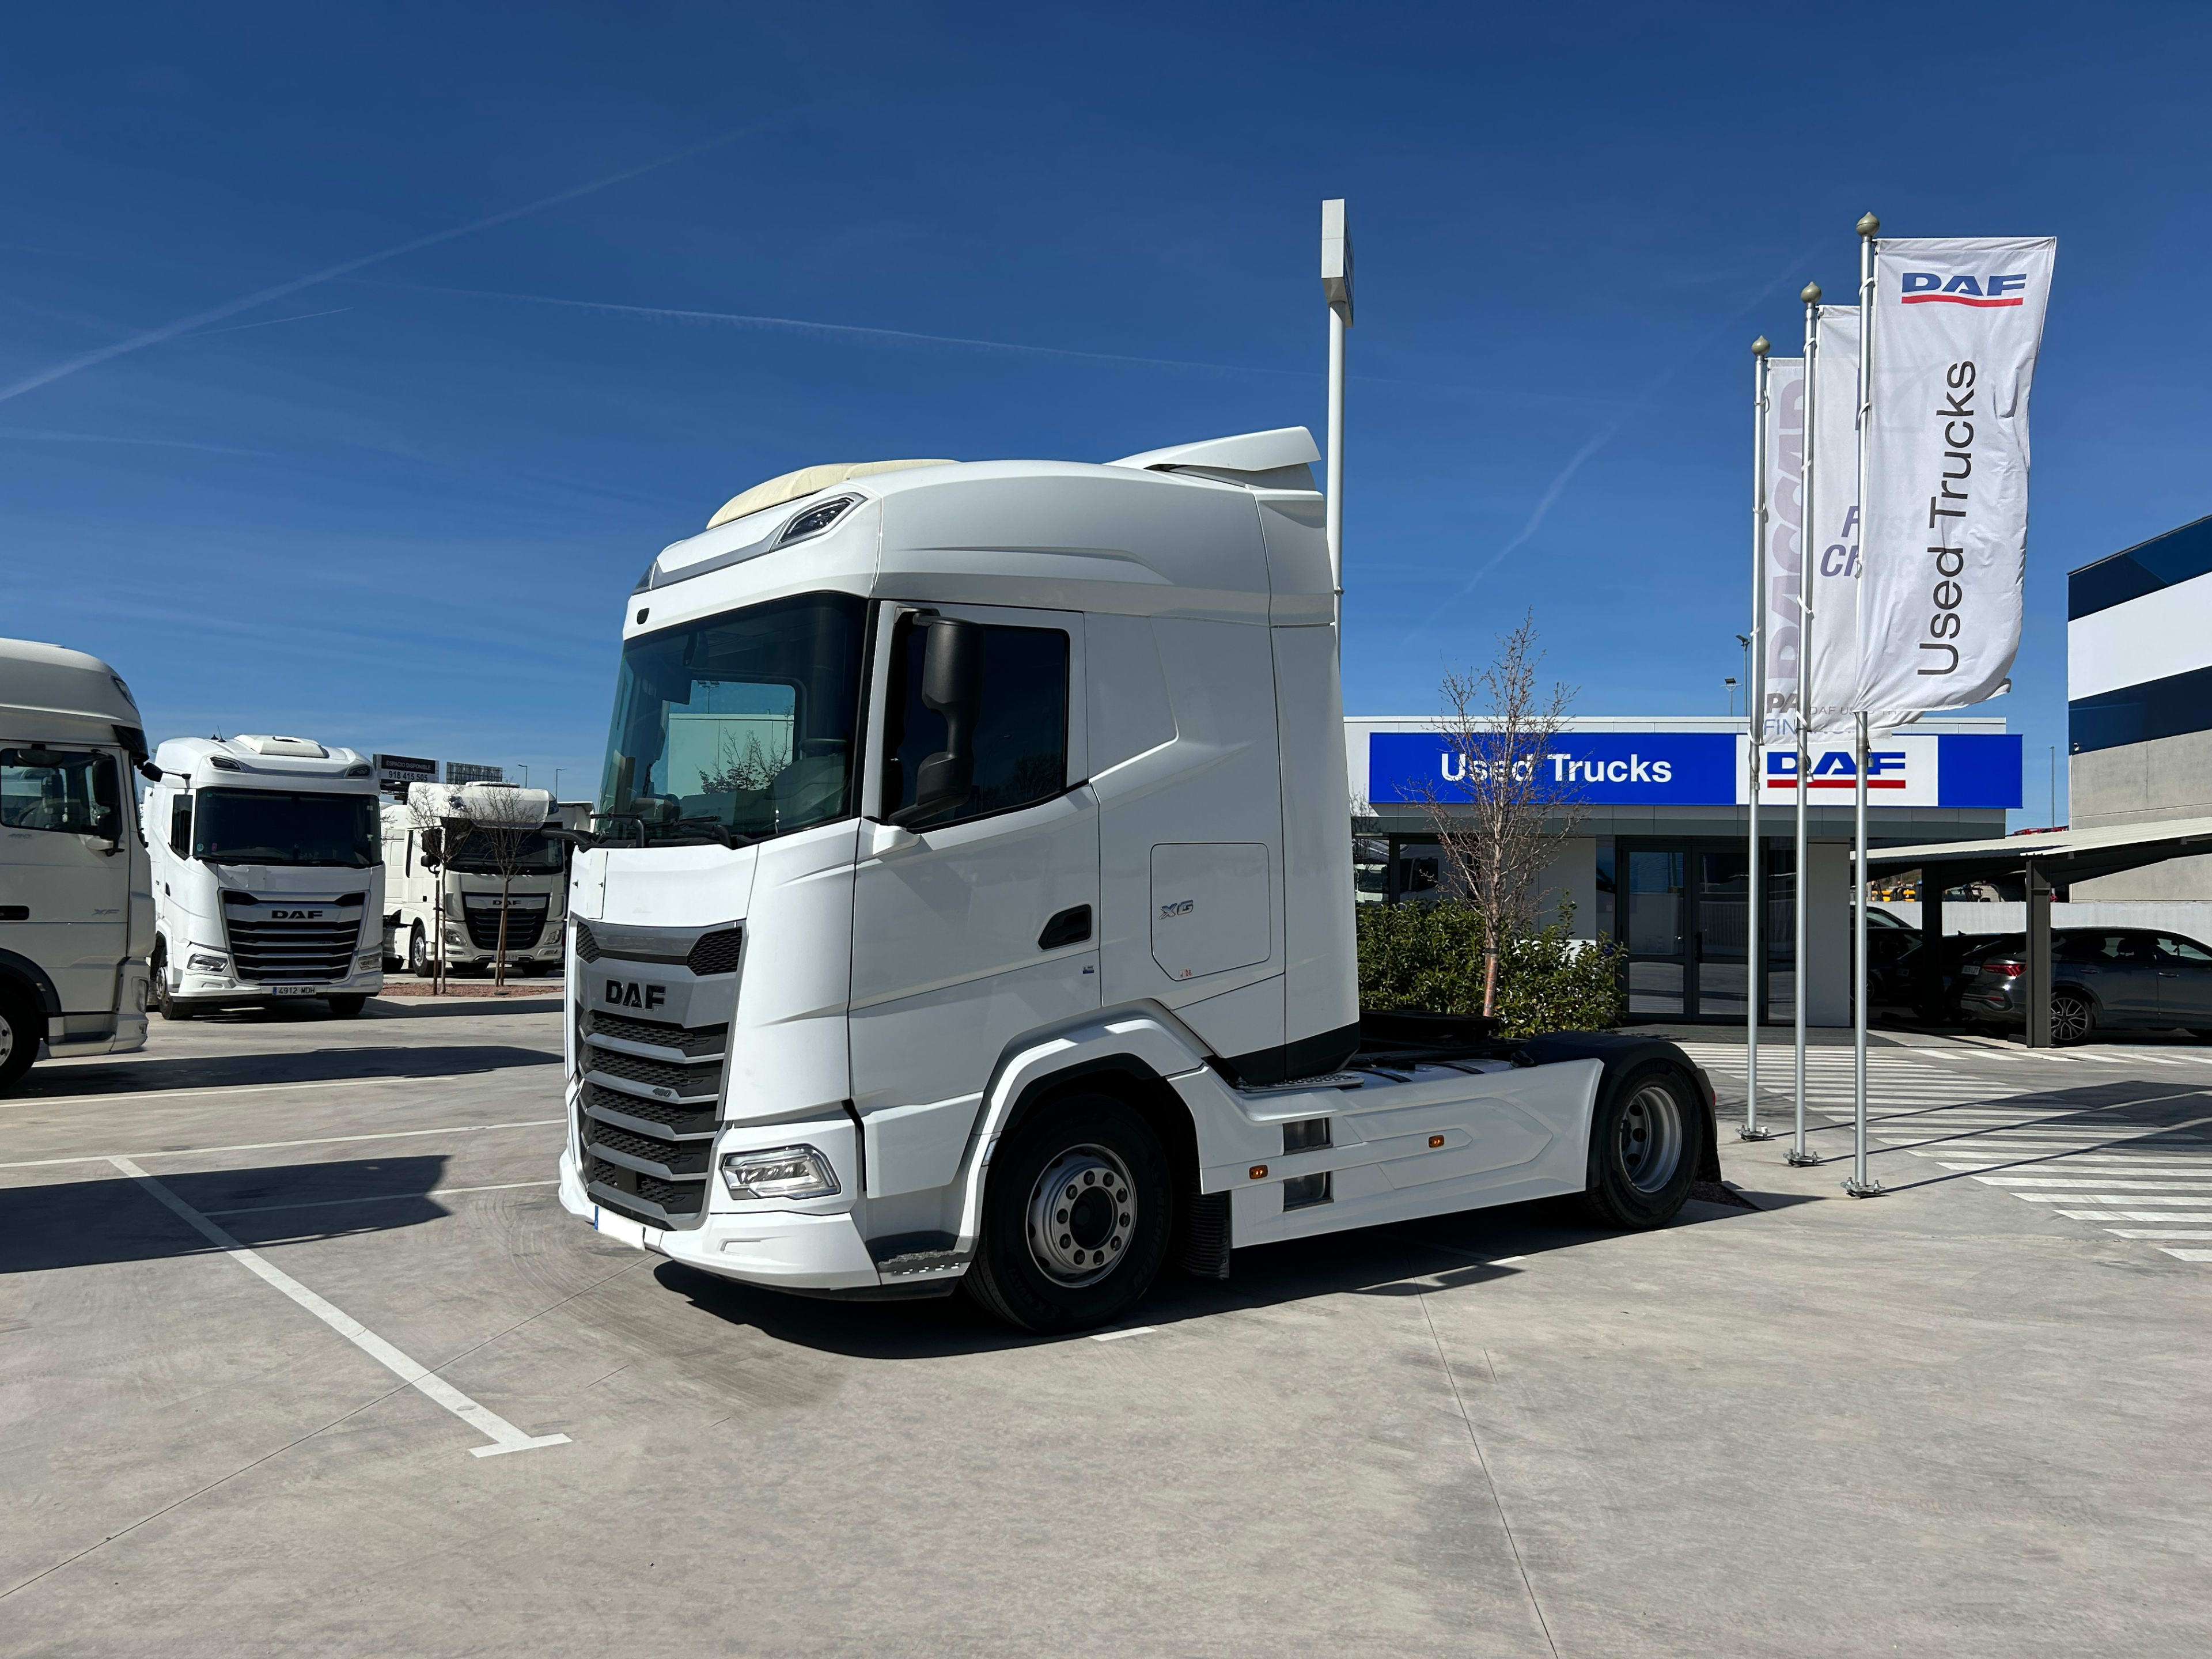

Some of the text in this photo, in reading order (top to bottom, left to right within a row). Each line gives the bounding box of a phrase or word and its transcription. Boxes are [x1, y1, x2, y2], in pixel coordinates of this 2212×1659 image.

[1902, 272, 2027, 296] DAF
[1917, 361, 1976, 675] Used Trucks
[406, 762, 431, 770] DISPONIBLE
[1441, 753, 1672, 783] Used Trucks
[1767, 752, 1906, 775] DAF
[389, 771, 401, 779] 918
[403, 772, 415, 781] 415
[271, 910, 323, 919] DAF
[1158, 900, 1194, 921] XG
[605, 979, 666, 1010] DAF
